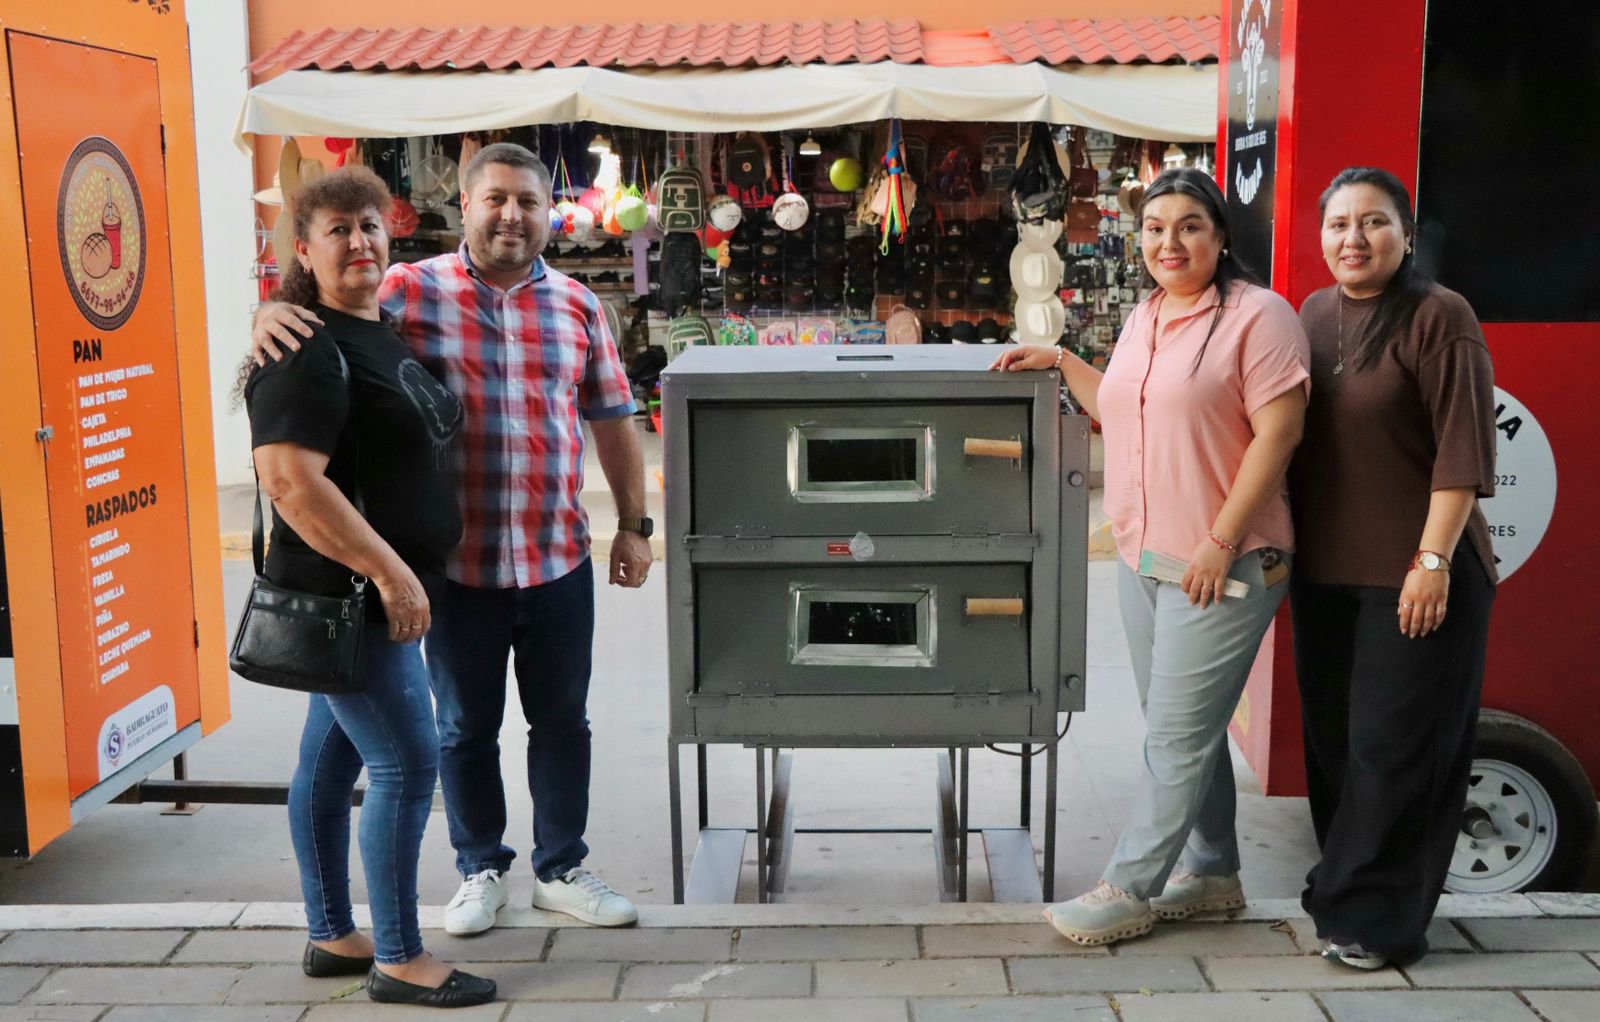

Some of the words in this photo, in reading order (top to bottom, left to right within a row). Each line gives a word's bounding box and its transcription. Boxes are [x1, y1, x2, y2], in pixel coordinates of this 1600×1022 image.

[73, 339, 102, 363] PAN
[79, 374, 93, 388] PAN
[94, 373, 104, 385] DE
[105, 369, 125, 384] MUJER
[126, 364, 154, 378] NATURAL
[80, 395, 95, 408] PAN
[95, 392, 105, 405] DE
[82, 413, 106, 429] CAJETA
[83, 426, 132, 448] PHILADELPHIA
[85, 447, 125, 469] EMPANADAS
[86, 468, 119, 488] CONCHAS
[86, 484, 157, 528] RASPADOS
[90, 528, 119, 548] CIRUELA
[91, 543, 130, 568] TAMARINDO
[93, 570, 113, 588] FRESA
[94, 584, 125, 607] VAINILLA
[96, 609, 112, 627] PIÑA
[98, 621, 129, 647] DURAZNO
[99, 645, 120, 666] LECHE
[121, 629, 151, 655] QUEMADA
[101, 660, 129, 685] GUAYABA
